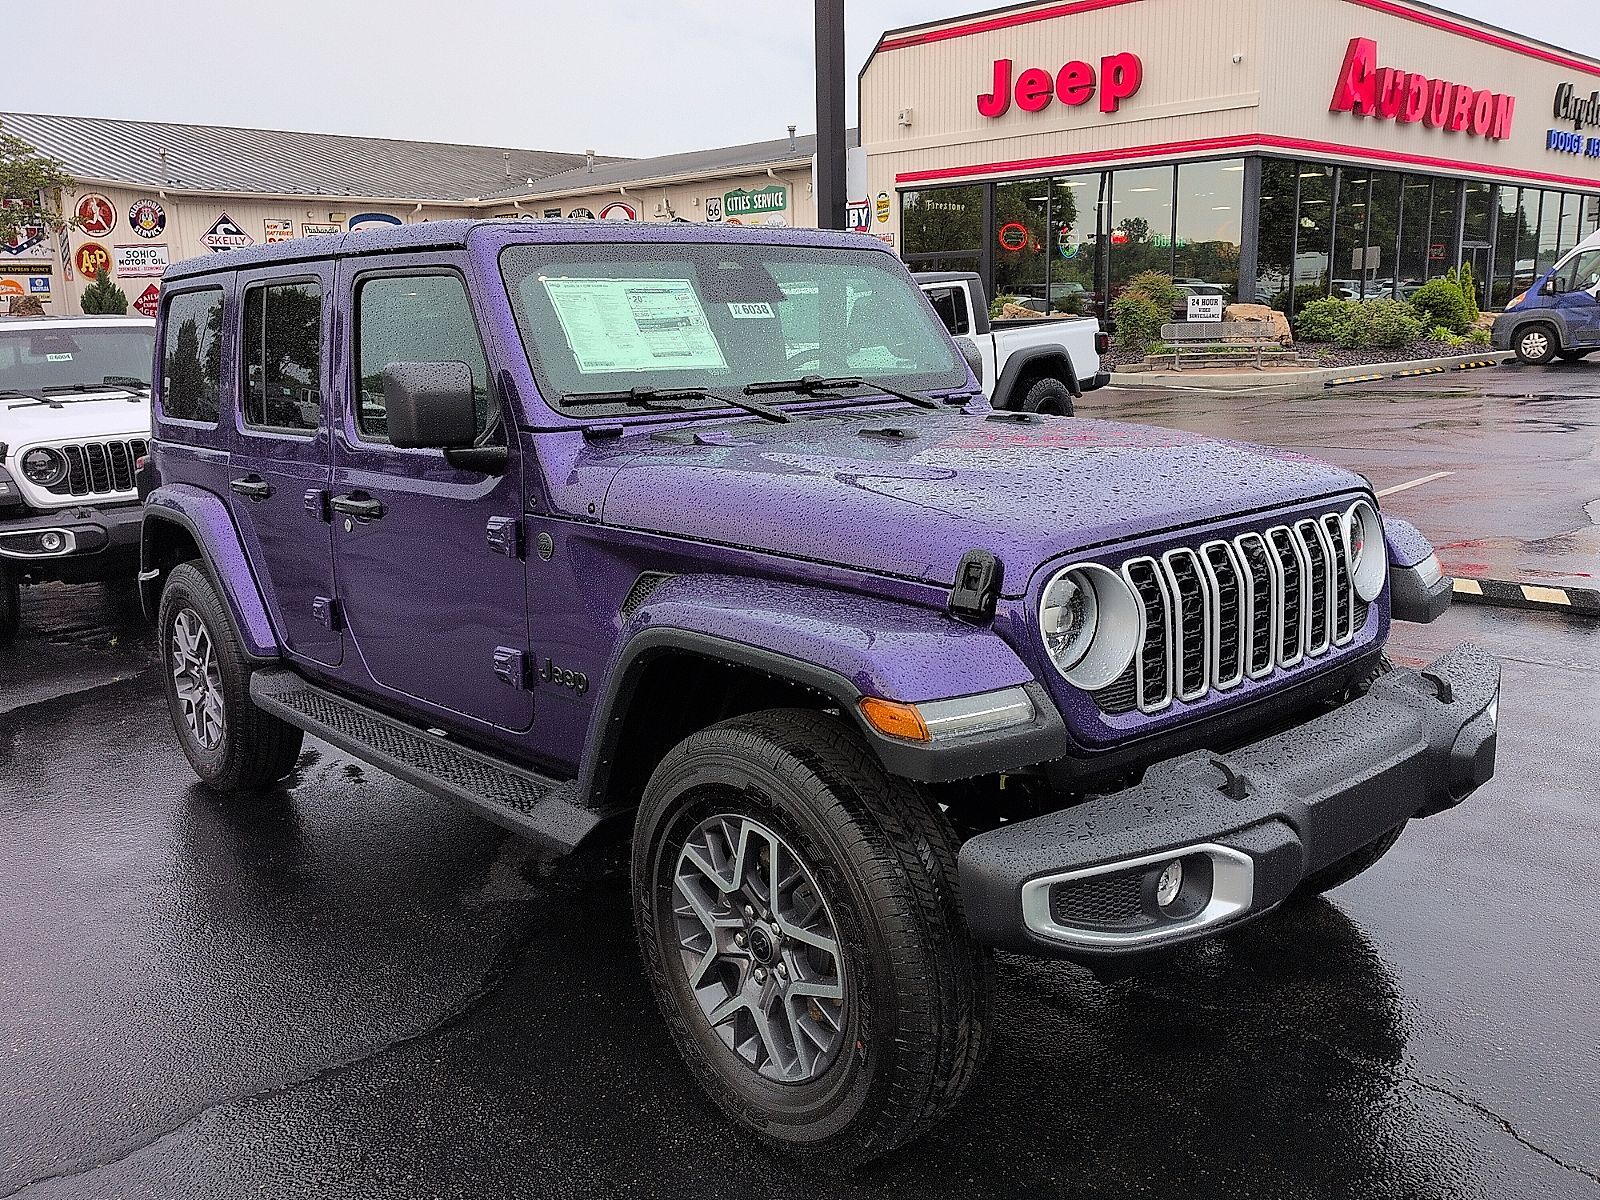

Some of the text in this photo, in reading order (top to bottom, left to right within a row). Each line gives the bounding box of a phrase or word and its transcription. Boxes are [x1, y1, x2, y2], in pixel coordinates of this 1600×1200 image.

[976, 52, 1143, 118] Jeep
[1329, 37, 1516, 141] AUDUBON
[1553, 82, 1600, 130] Chrysl
[1546, 130, 1600, 158] DODGE JE
[129, 200, 165, 218] OLDSMOBILE
[707, 203, 720, 217] 66
[727, 191, 784, 212] CITIES SERVICE
[925, 199, 966, 211] Firestone
[571, 208, 590, 218] DIXIE
[846, 207, 869, 227] BY
[134, 225, 163, 238] SERVICE
[207, 236, 247, 246] SKELLY
[81, 249, 107, 273] A&P
[125, 250, 157, 259] SOHIO
[1191, 298, 1219, 306] 24 HOUR
[539, 657, 590, 697] Jeep
